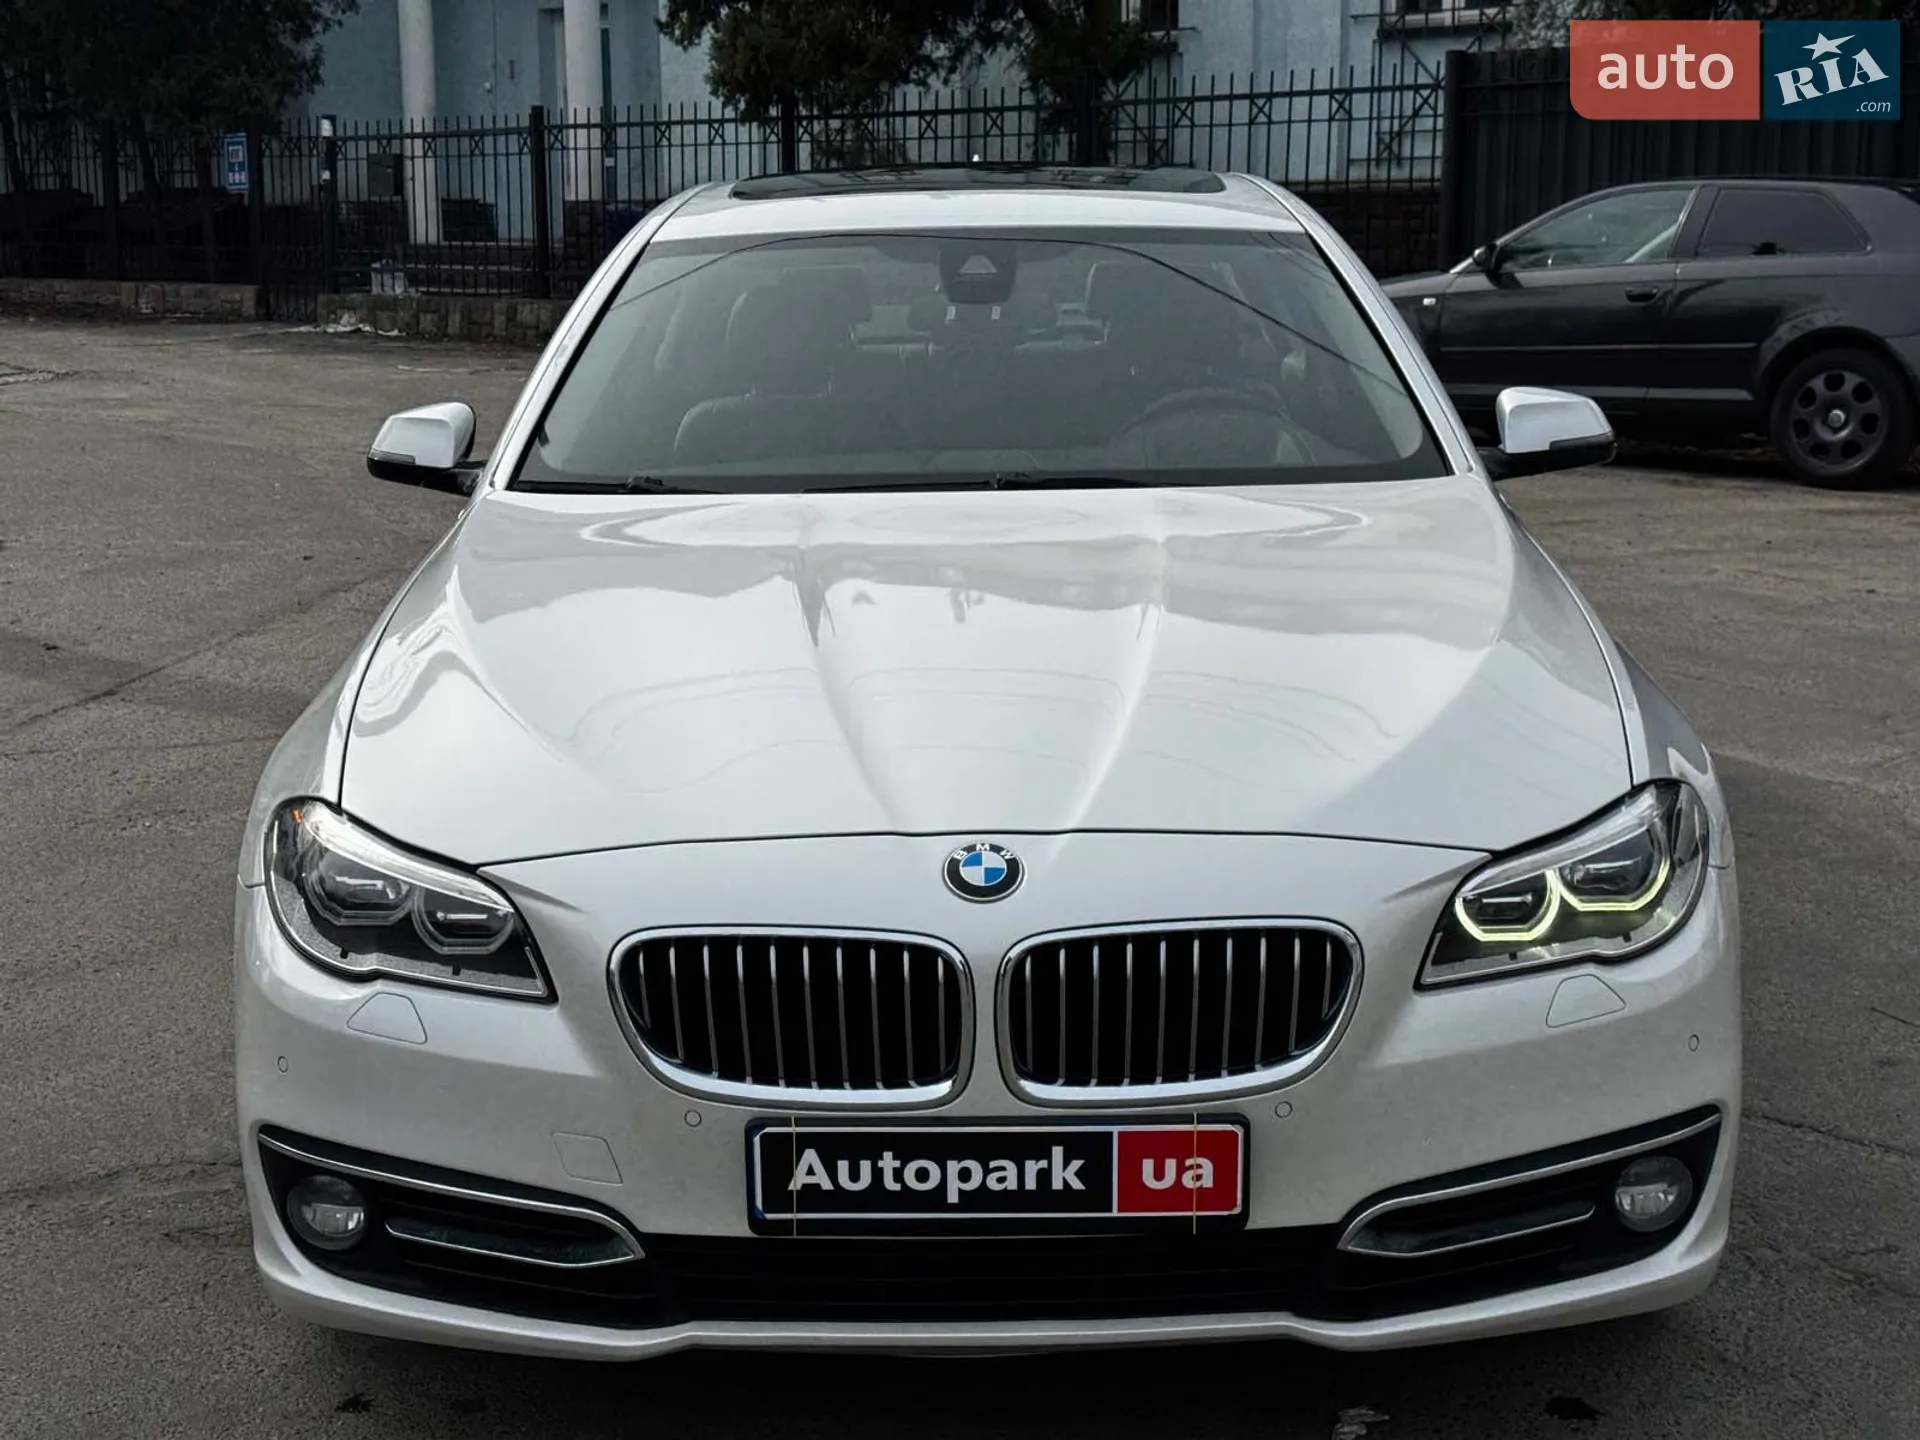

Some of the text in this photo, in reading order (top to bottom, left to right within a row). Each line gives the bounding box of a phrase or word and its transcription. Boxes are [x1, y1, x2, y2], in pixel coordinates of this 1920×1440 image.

[952, 843, 1016, 860] BMW
[787, 1145, 1215, 1204] Autopark ua
